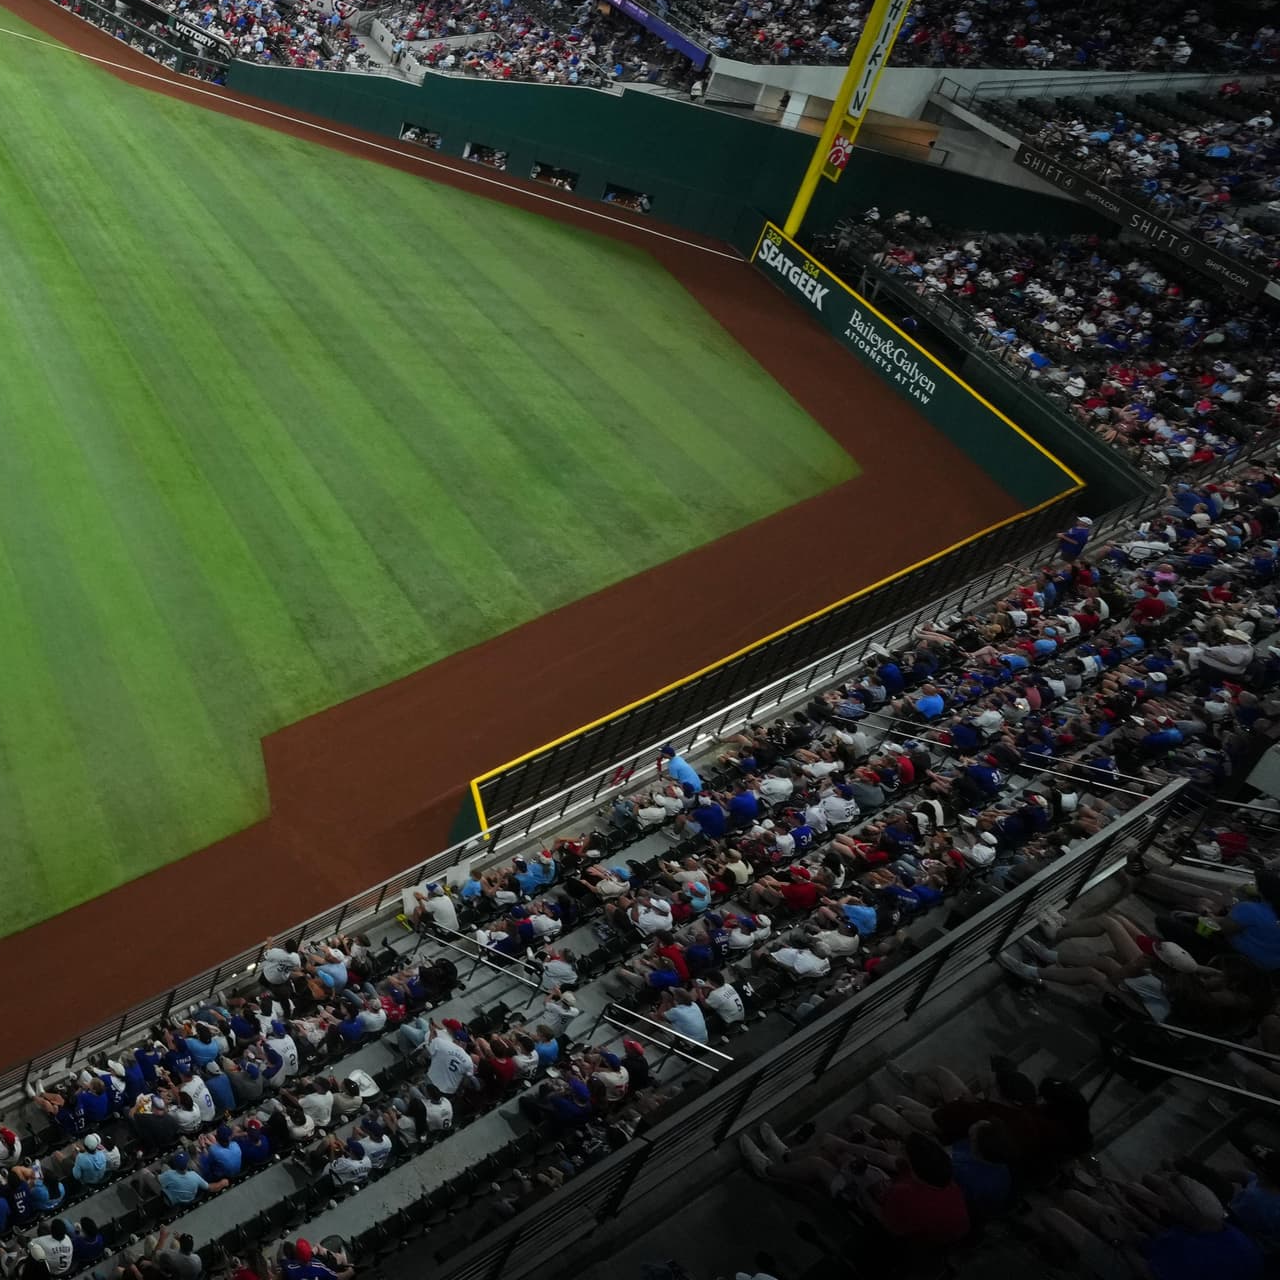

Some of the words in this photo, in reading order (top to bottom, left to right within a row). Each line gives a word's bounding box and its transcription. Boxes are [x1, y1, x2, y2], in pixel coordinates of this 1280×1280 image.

[1023, 152, 1064, 183] SHIFT
[766, 229, 783, 247] 329
[1130, 214, 1180, 249] SHIFT
[758, 238, 831, 312] SEATGEEK
[802, 260, 821, 279] 334
[844, 328, 892, 373] ATTORNEYS
[894, 372, 908, 386] AT
[909, 384, 931, 405] LAW
[848, 309, 937, 395] Bailey&Galyen
[448, 1059, 460, 1073] 5
[16, 1200, 26, 1214] 5
